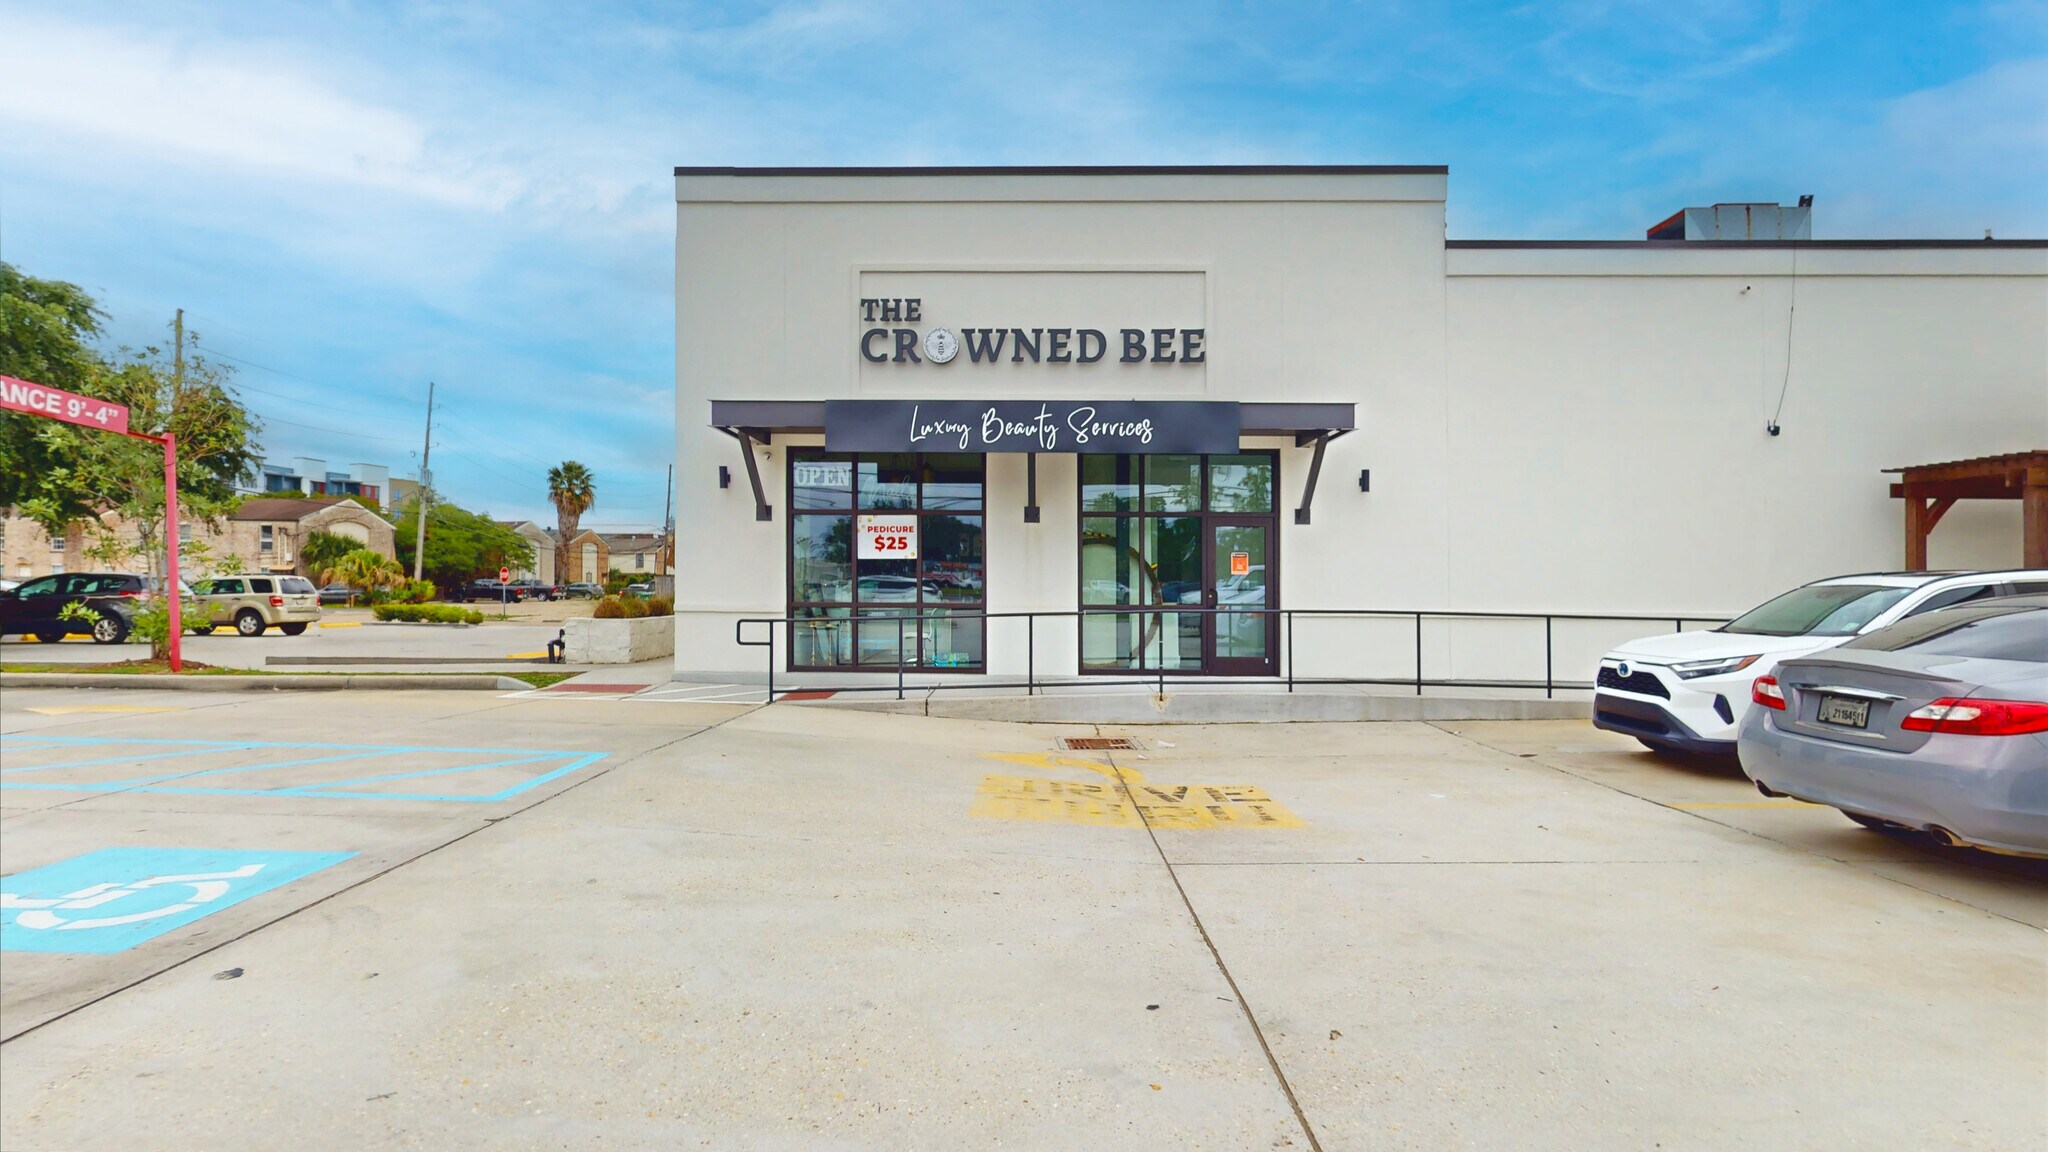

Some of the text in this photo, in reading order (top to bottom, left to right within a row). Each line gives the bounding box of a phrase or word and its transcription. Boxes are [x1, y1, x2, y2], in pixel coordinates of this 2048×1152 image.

[861, 298, 921, 322] THE
[1119, 328, 1205, 363] BEE
[910, 403, 1154, 450] Luxury Beauty Services
[795, 467, 850, 486] OPEN
[867, 525, 915, 533] PEDICURE
[874, 535, 908, 552] $25
